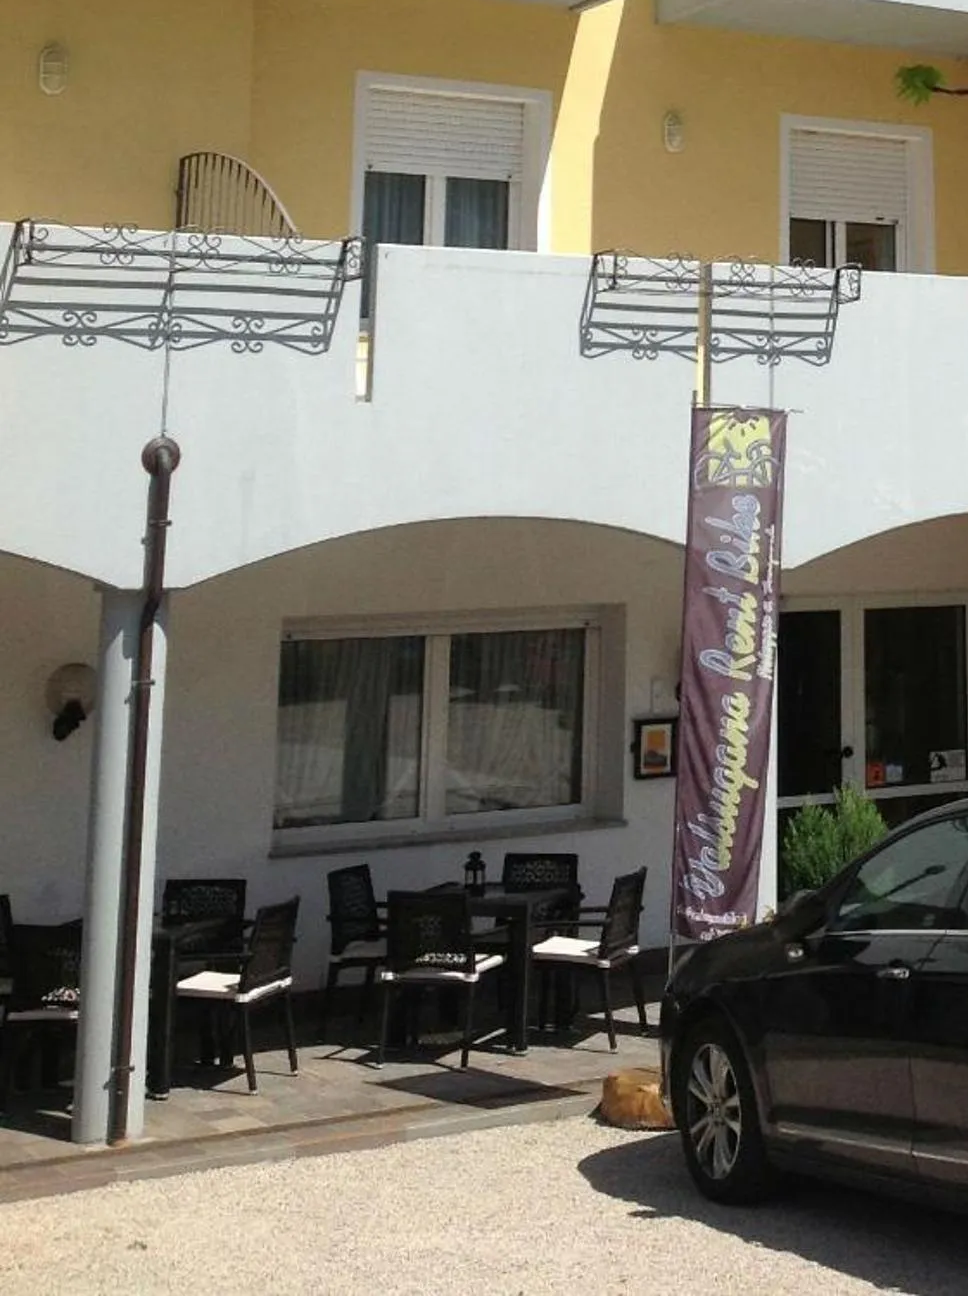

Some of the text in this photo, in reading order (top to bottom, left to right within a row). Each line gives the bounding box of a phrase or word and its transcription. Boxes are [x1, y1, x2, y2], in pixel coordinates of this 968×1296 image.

[704, 494, 761, 585] Bike
[699, 586, 757, 681] Rent
[682, 692, 759, 900] Valsugana
